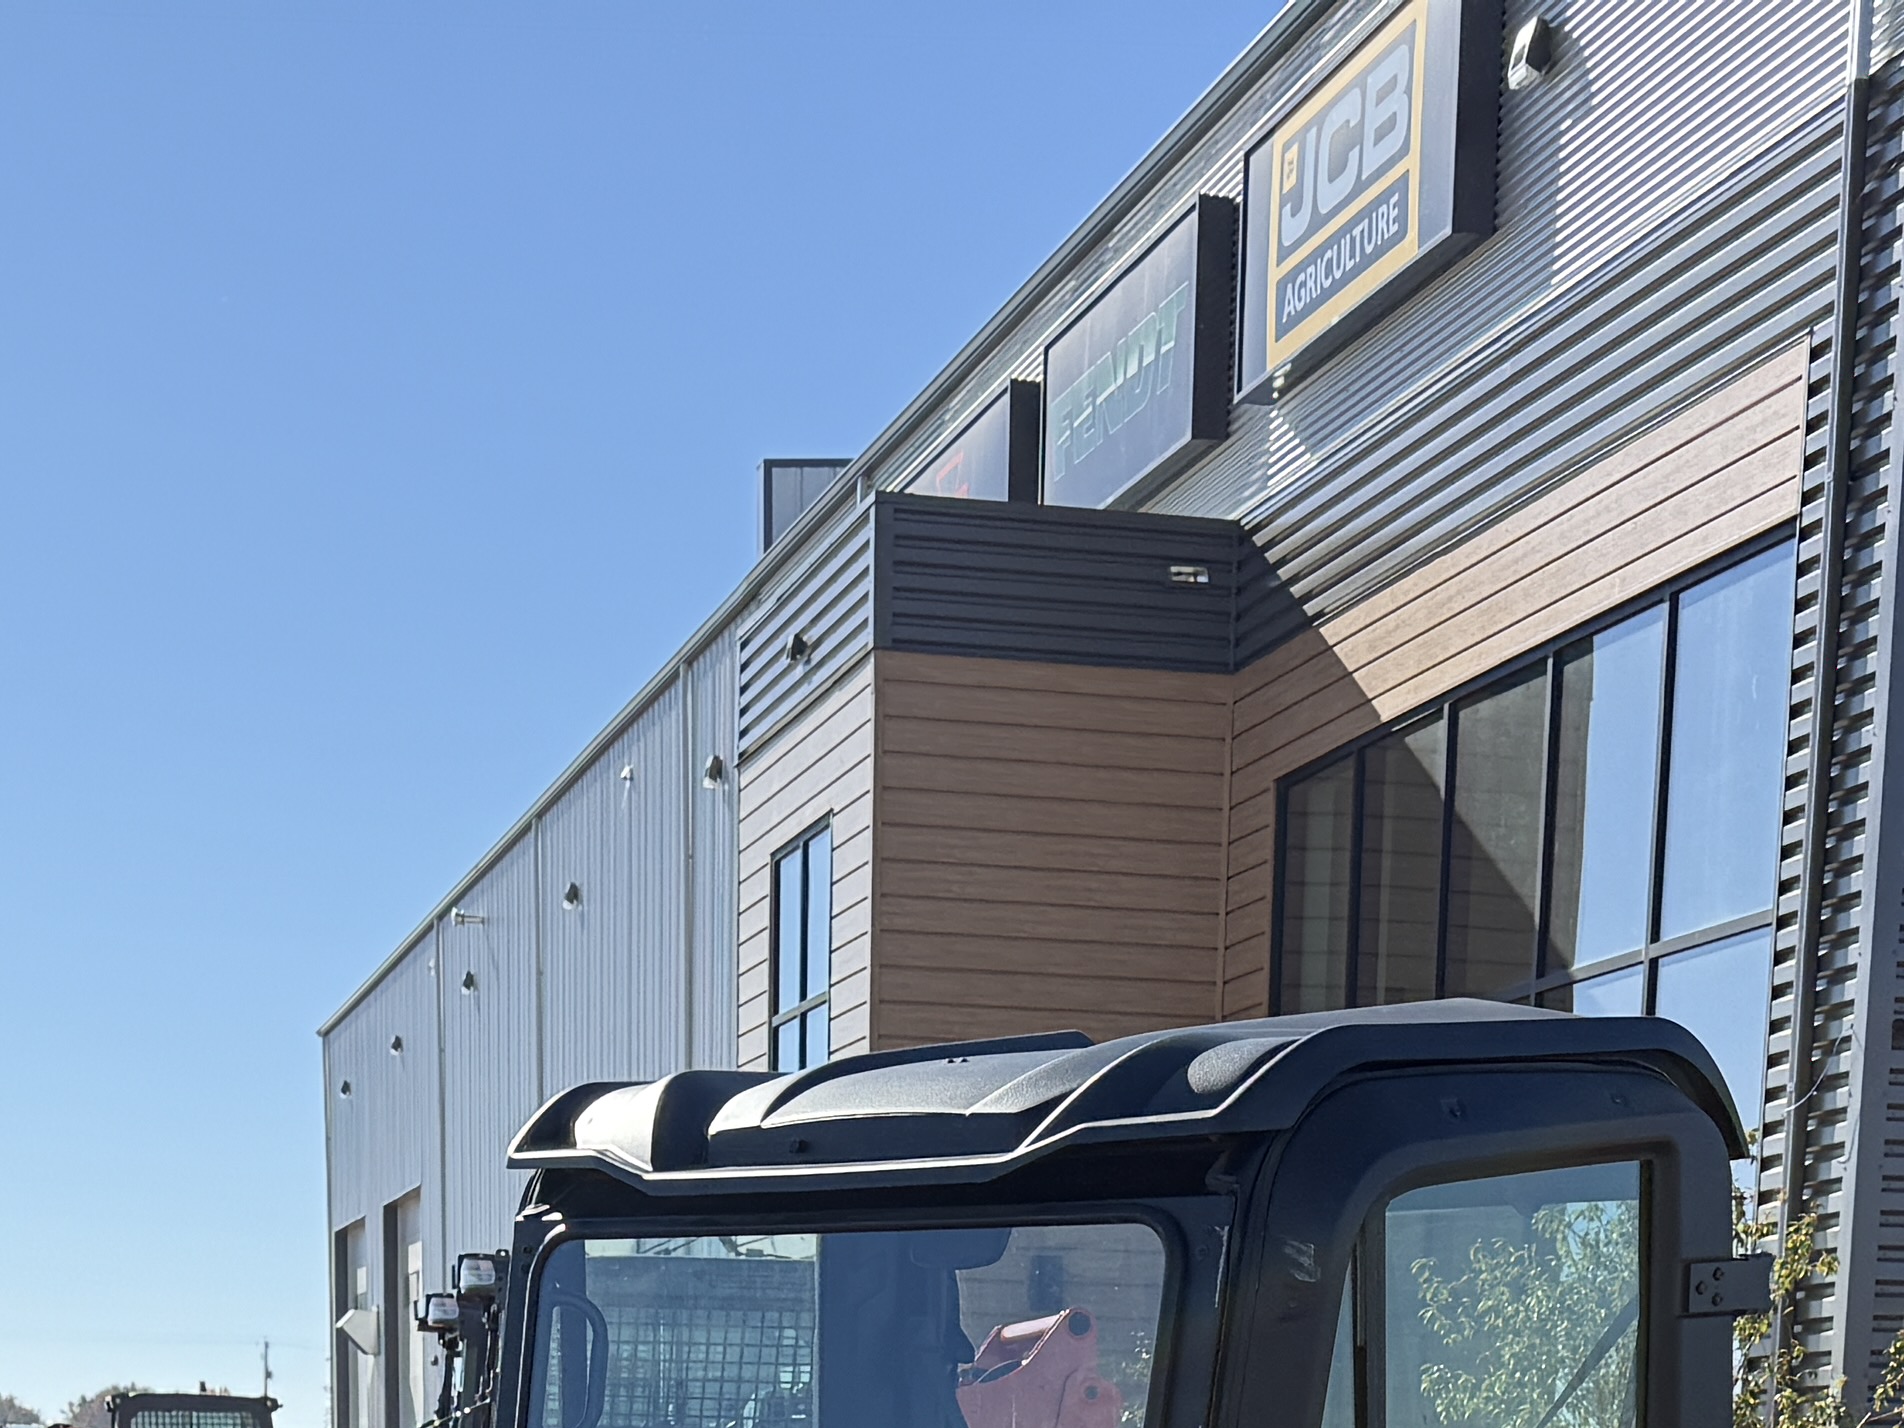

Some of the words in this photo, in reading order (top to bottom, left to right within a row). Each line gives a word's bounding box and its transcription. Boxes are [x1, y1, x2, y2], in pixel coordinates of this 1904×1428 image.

[1280, 44, 1410, 247] JCB
[1281, 192, 1400, 324] AGRICULTURE
[1051, 281, 1190, 483] FENDT
